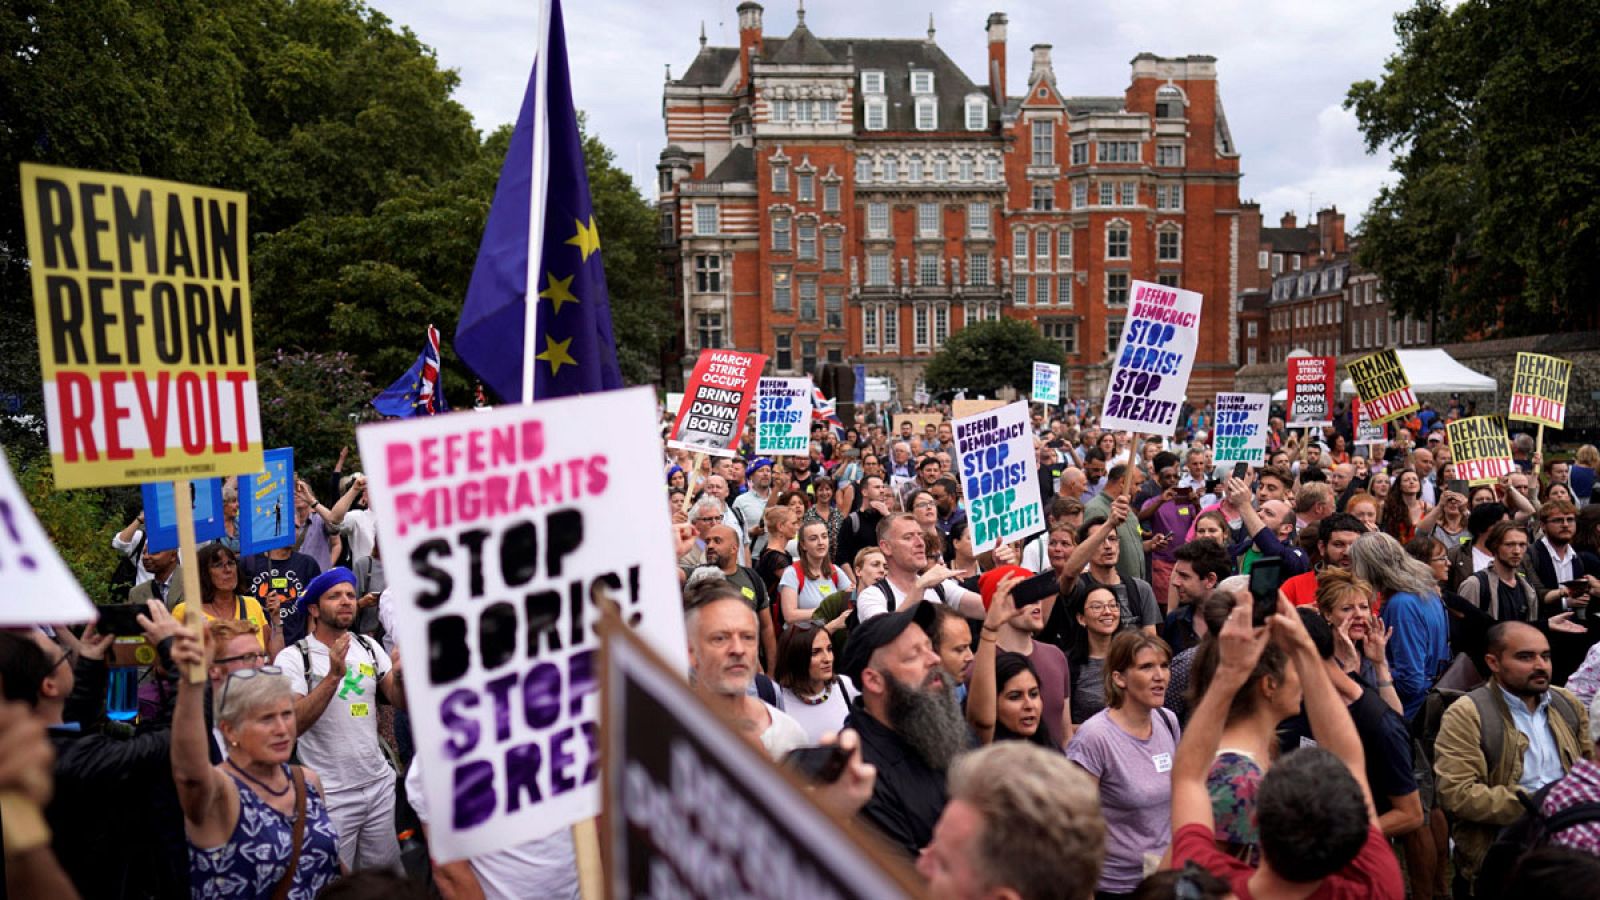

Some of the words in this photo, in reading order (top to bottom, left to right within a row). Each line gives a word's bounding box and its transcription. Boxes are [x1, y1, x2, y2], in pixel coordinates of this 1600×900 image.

[35, 176, 240, 281] REMAIN
[1136, 286, 1177, 306] DEFEND
[46, 275, 246, 365] REFORM
[1126, 319, 1176, 348] STOP
[708, 363, 746, 378] STRIKE
[710, 353, 752, 367] MARCH
[1119, 343, 1183, 376] BORIS!
[1349, 349, 1399, 383] REMAIN
[1519, 354, 1568, 382] REMAIN
[702, 373, 748, 388] OCCUPY
[759, 379, 788, 388] DEFEND
[1112, 368, 1162, 397] STOP
[1296, 383, 1325, 393] BRING
[1356, 366, 1408, 402] REFORM
[1515, 375, 1565, 399] REFORM
[697, 387, 742, 404] BRING
[759, 396, 793, 409] STOP
[1295, 393, 1325, 403] DOWN
[1296, 403, 1324, 413] BORIS
[1364, 387, 1415, 424] REVOLT
[56, 370, 250, 463] REVOLT
[692, 402, 738, 419] DOWN
[759, 410, 803, 423] BORIS!
[1105, 394, 1177, 425] BREXIT!
[1216, 411, 1249, 423] STOP
[1512, 394, 1564, 423] REVOLT
[688, 417, 731, 435] BORIS
[759, 423, 792, 436] STOP
[957, 415, 998, 440] DEFEND
[960, 421, 1025, 454] DEMOCRACY
[1216, 424, 1259, 436] BORIS!
[1450, 416, 1506, 441] REMAIN
[385, 419, 545, 488] DEFEND
[759, 436, 807, 450] BREXIT!
[1215, 436, 1248, 448] STOP
[1215, 448, 1263, 461] BREXIT!
[1453, 436, 1509, 461] REFORM
[963, 443, 1009, 477] STOP
[1456, 456, 1513, 480] REVOLT
[967, 461, 1027, 500] BORIS!
[394, 455, 610, 536] MIGRANTS
[971, 488, 1016, 523] STOP
[975, 502, 1039, 546] BREXIT!
[410, 507, 585, 610] STOP
